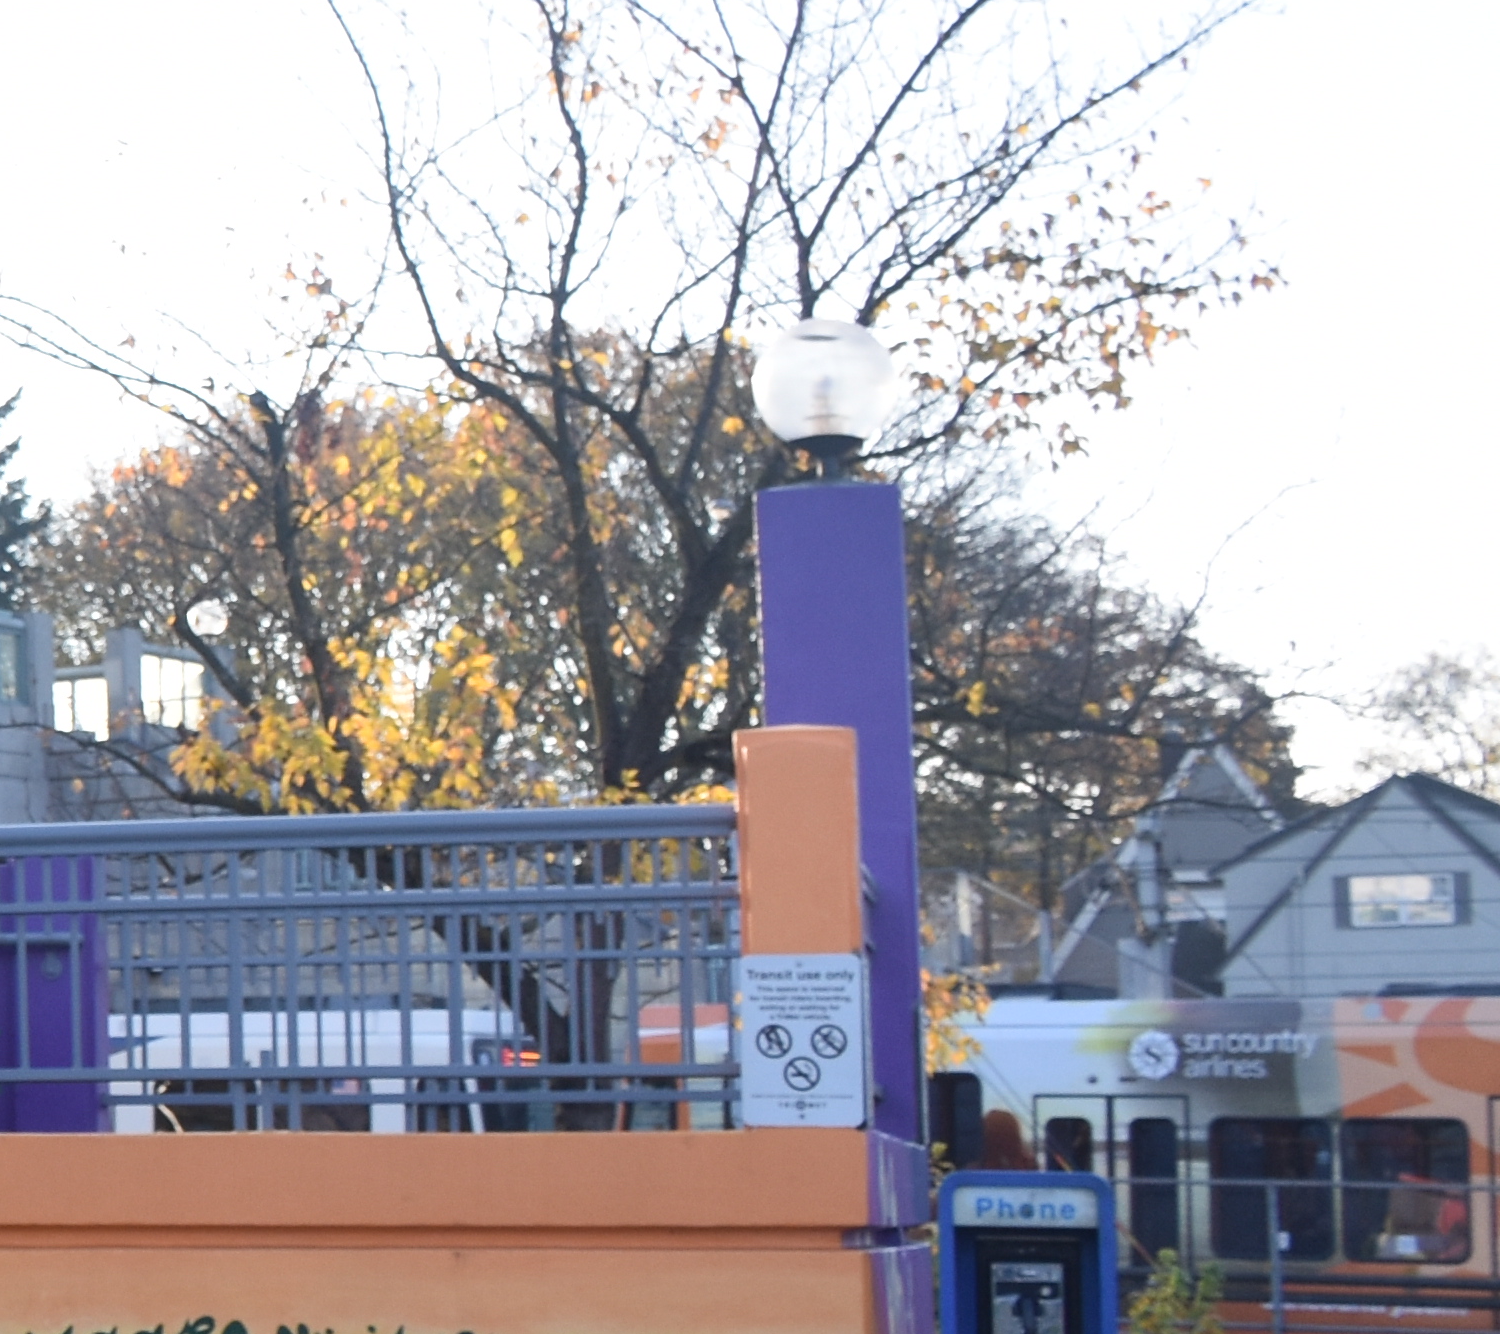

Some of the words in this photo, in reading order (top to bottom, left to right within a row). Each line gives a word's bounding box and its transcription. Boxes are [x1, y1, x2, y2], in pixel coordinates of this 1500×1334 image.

[747, 969, 792, 981] Transit
[797, 971, 821, 981] use
[825, 970, 855, 984] only
[1182, 1055, 1268, 1079] airlines
[975, 1197, 1076, 1219] Phone
